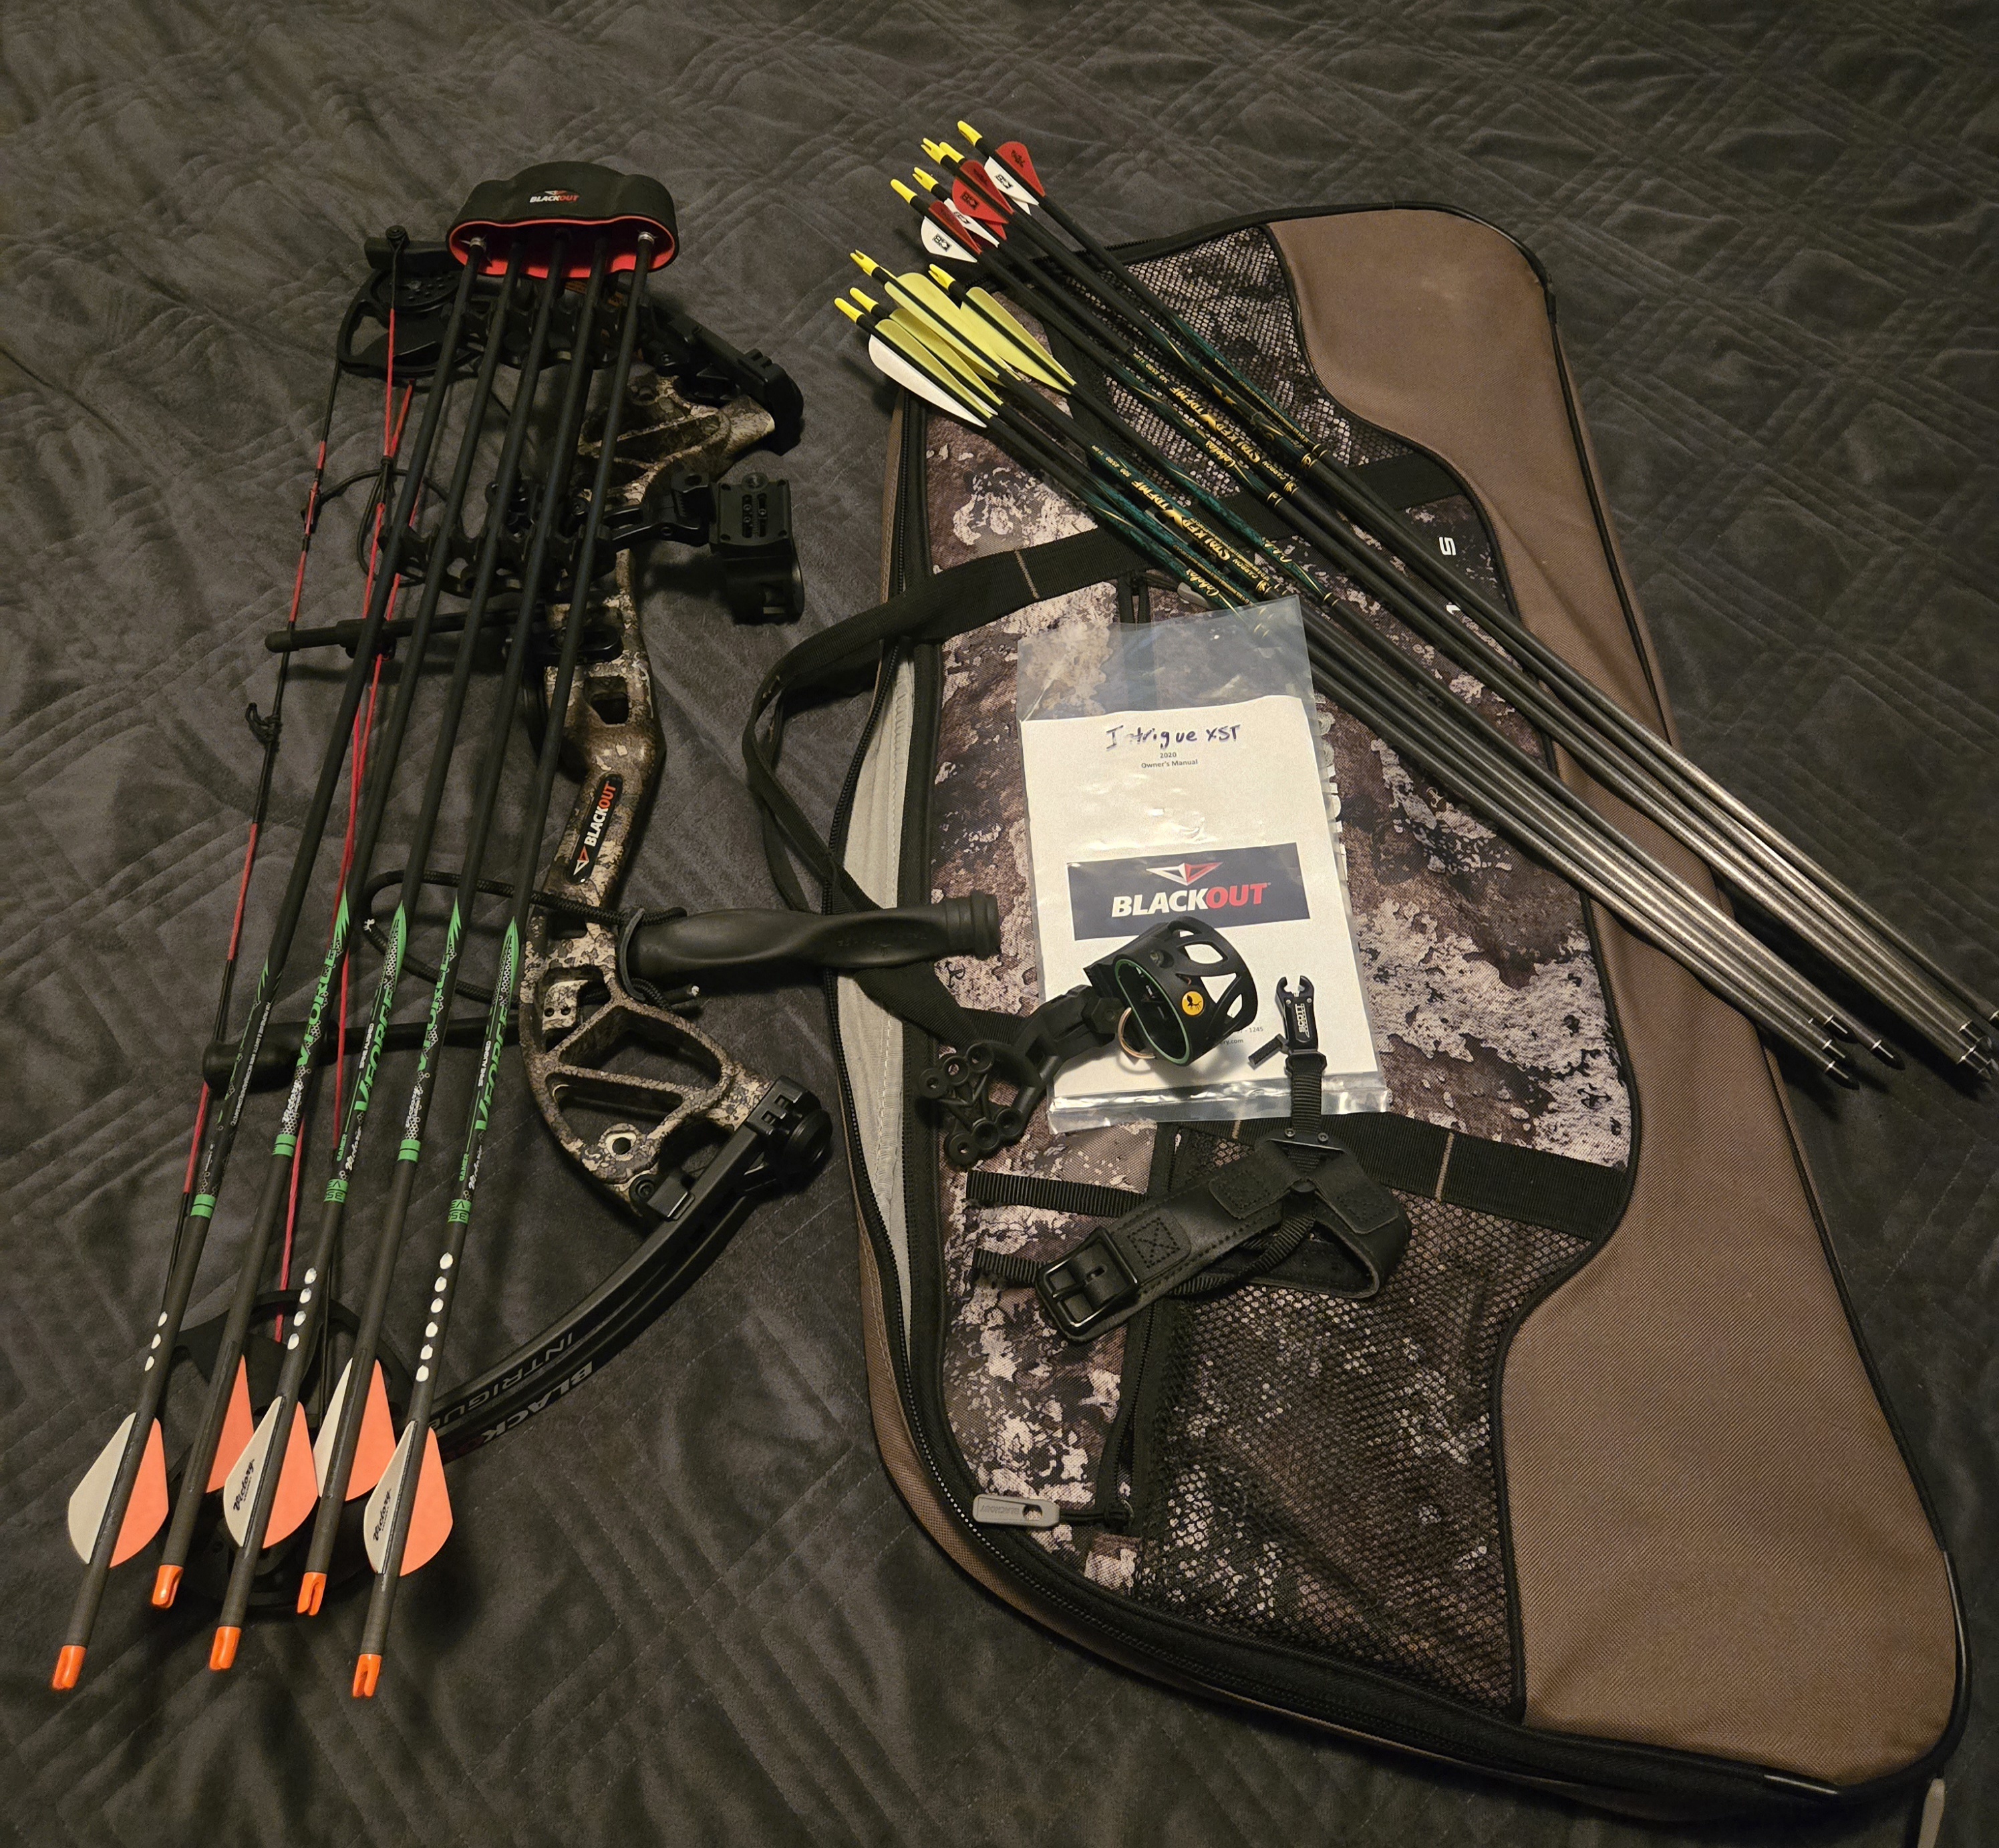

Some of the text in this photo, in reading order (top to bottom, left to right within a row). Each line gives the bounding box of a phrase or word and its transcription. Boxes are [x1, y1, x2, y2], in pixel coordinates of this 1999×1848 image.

[529, 194, 580, 203] BLACKOUT
[1203, 438, 1236, 470] Cabela's
[1119, 466, 1132, 478] 500
[1183, 567, 1220, 597] Cabela's
[1205, 724, 1241, 742] XST
[1171, 759, 1199, 767] Manual
[583, 781, 617, 847] BLACKOUT
[1111, 883, 1267, 917] BLACKOUT
[1294, 1004, 1305, 1032] SCOTT
[359, 1023, 373, 1068] SPINE ALIGNED
[482, 1040, 491, 1066] ALIGNED
[337, 1134, 347, 1161] GAMER
[459, 1154, 468, 1180] GAMER
[448, 1211, 468, 1222] 35
[428, 1332, 573, 1429] INTRIGUE
[232, 1458, 255, 1511] Victory
[372, 1488, 391, 1540] Victory
